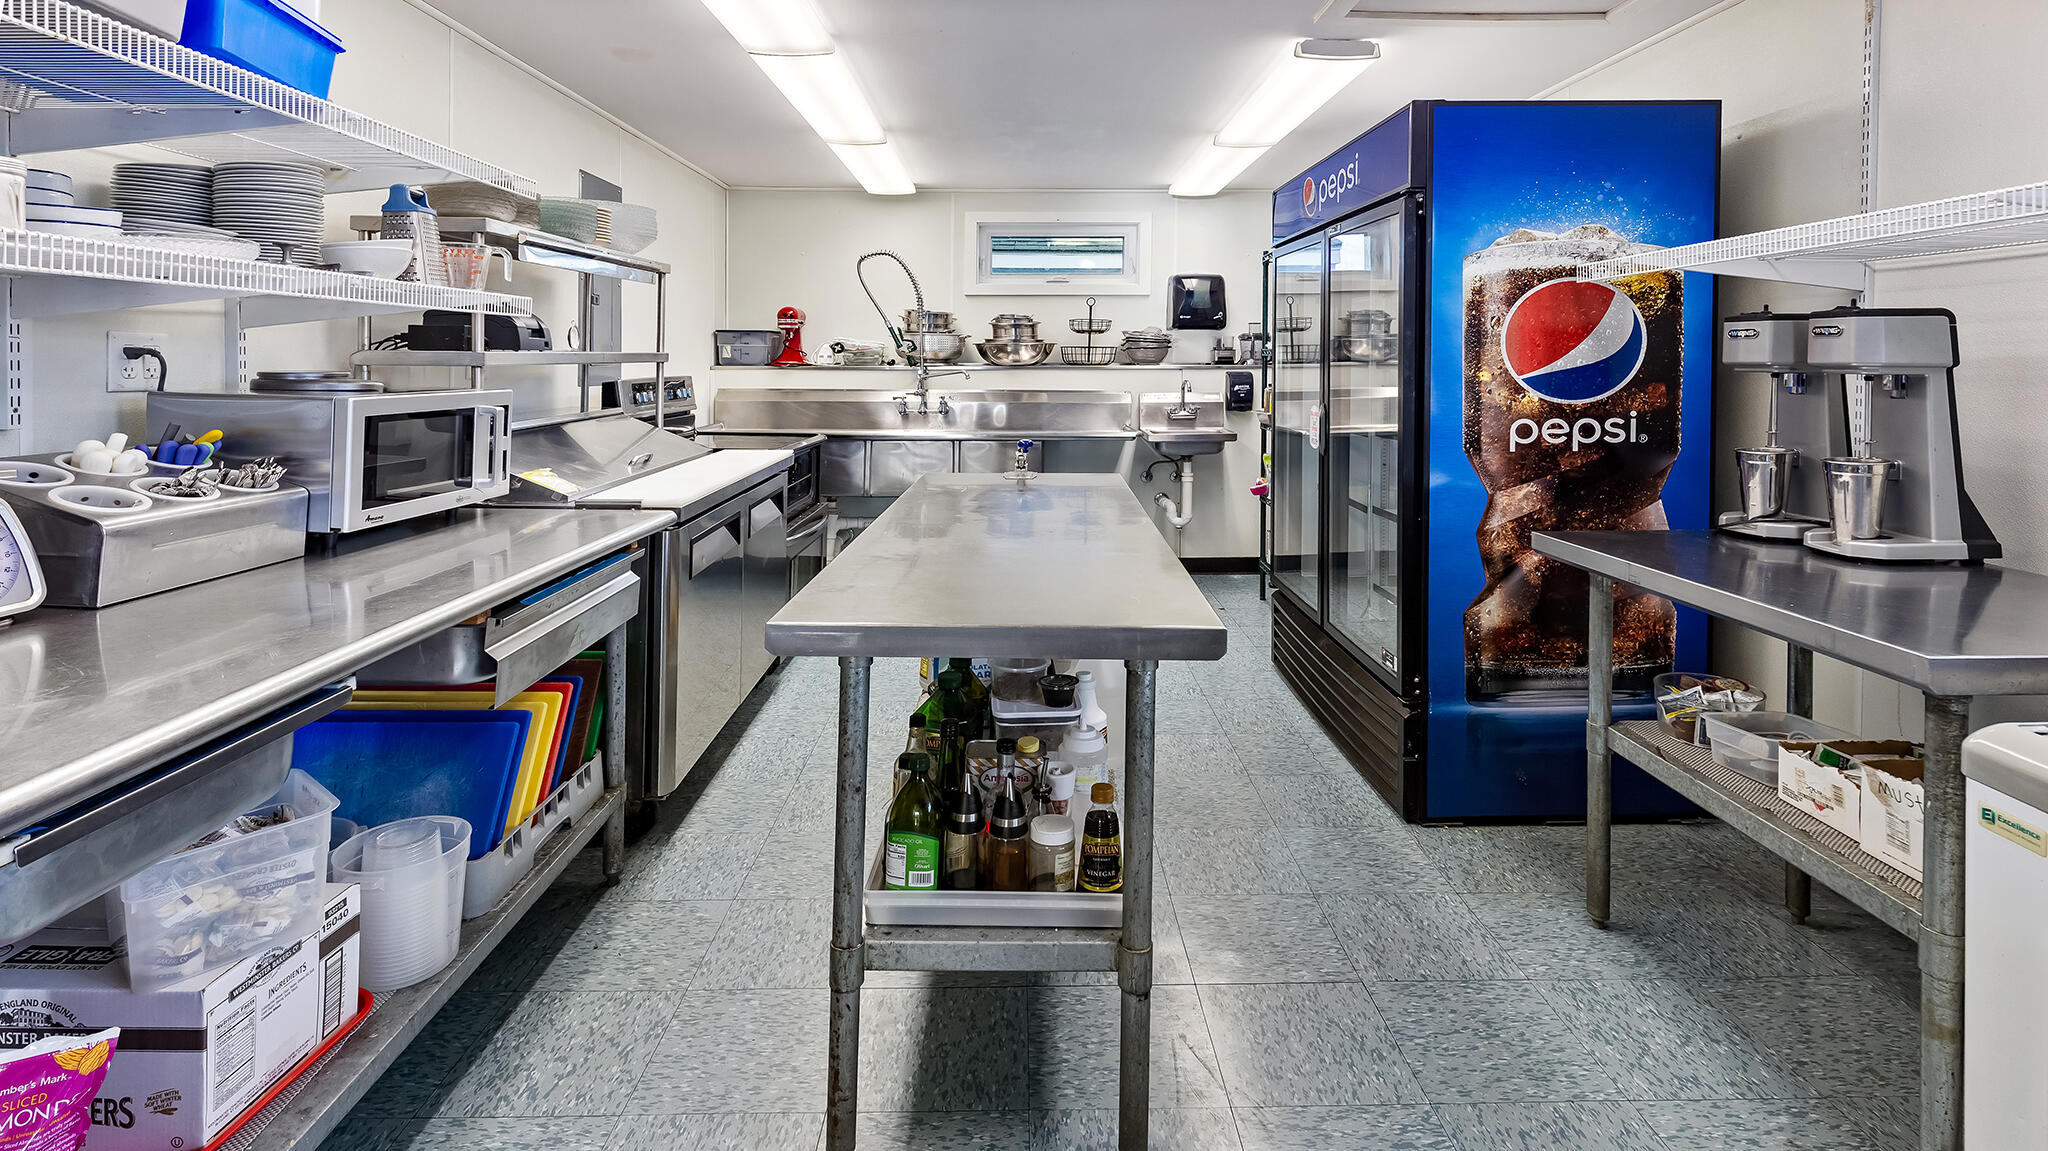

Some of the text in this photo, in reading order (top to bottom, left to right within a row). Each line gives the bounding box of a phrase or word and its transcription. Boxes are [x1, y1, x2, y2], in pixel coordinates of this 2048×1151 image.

[1318, 152, 1359, 212] pepsi
[1509, 410, 1637, 452] pepsi
[983, 773, 1029, 783] Amsia
[1998, 814, 2040, 841] Excellence
[1084, 843, 1120, 855] POMPEIAN
[1086, 869, 1116, 877] VINEGAR
[321, 908, 349, 933] 15040
[268, 961, 307, 999] INGREDIENTS
[41, 1000, 77, 1023] ORIGINAL
[40, 1073, 67, 1086] Mark
[1, 1093, 48, 1112] SLICED
[91, 1096, 136, 1129] ERS
